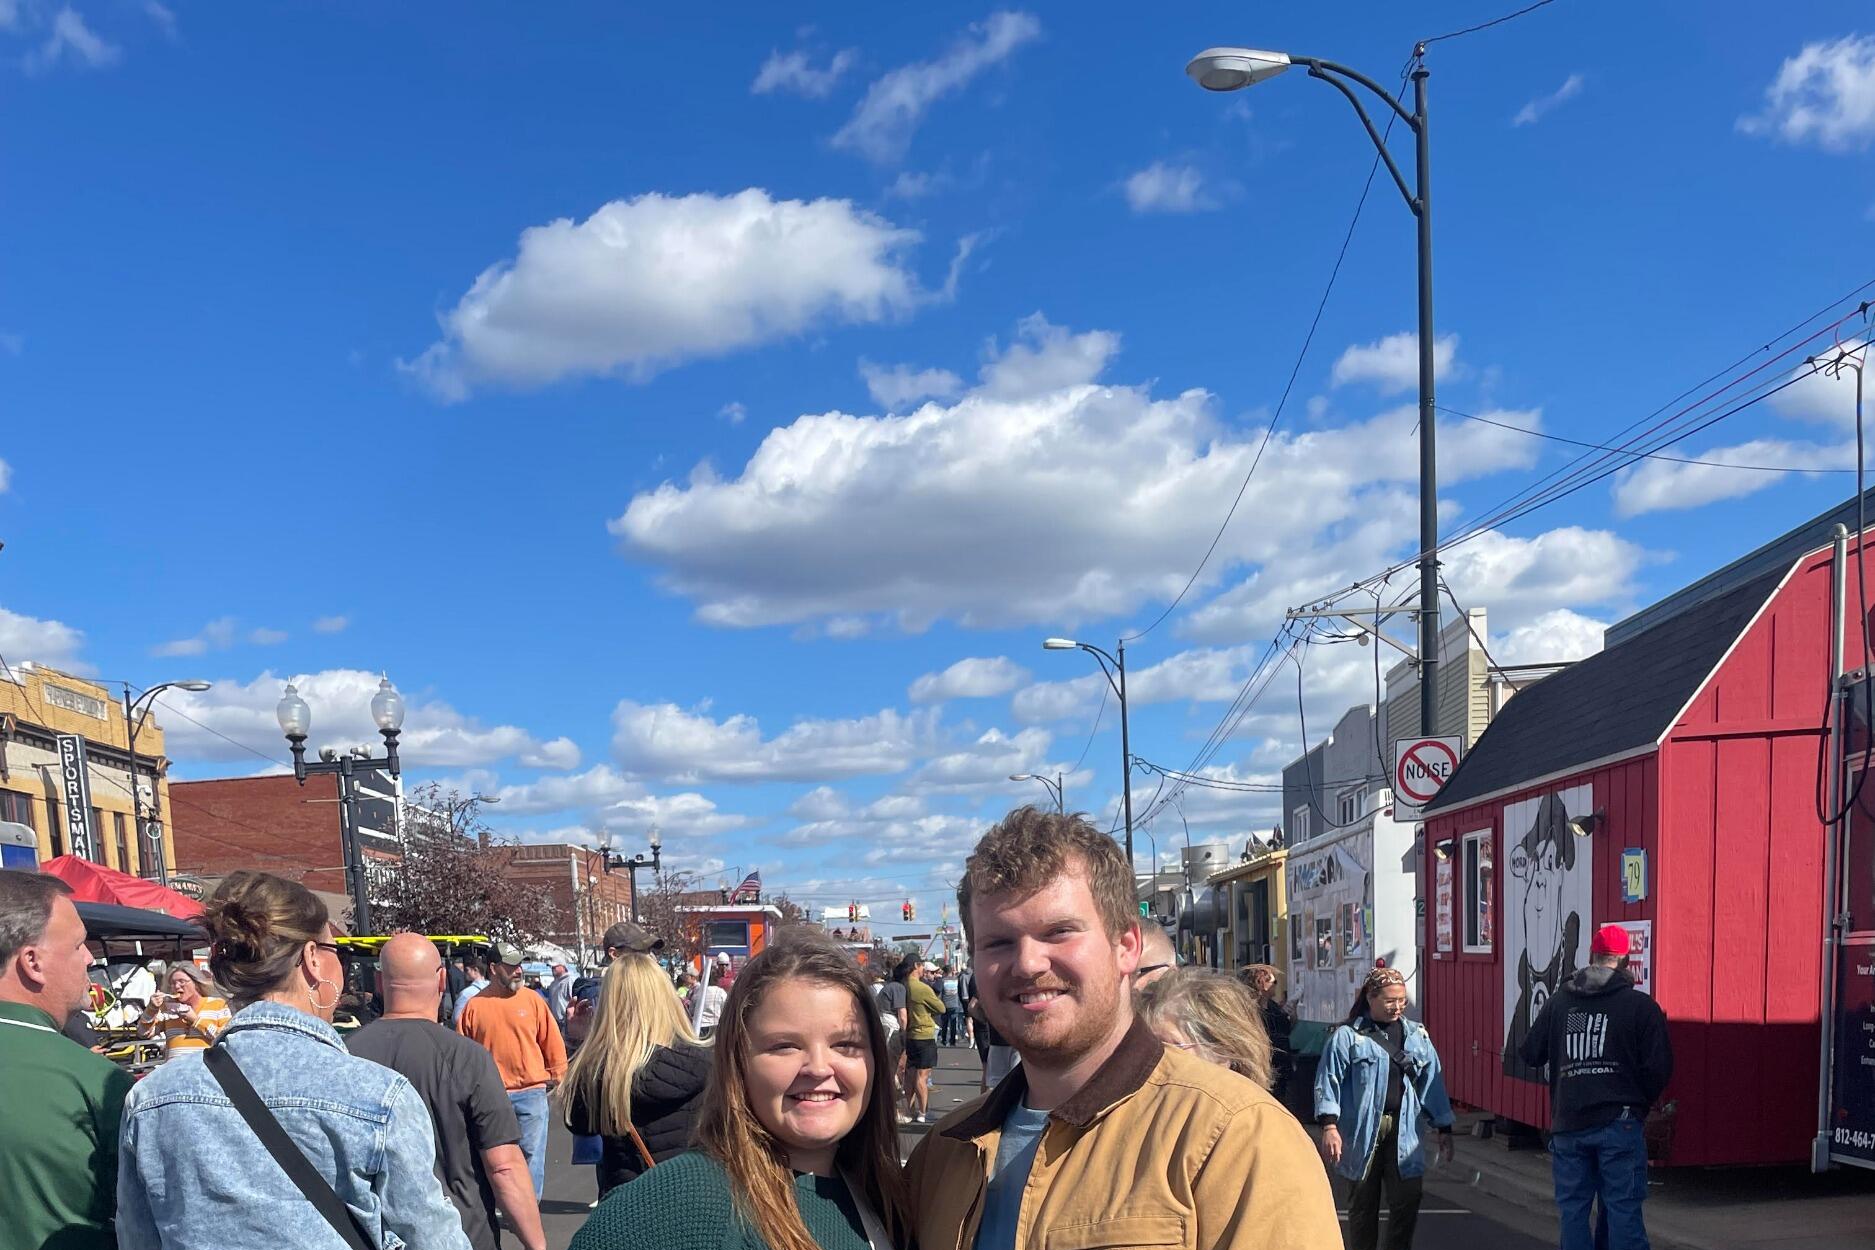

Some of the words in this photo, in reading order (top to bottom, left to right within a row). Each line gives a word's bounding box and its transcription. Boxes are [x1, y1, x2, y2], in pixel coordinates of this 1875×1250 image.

[1406, 761, 1450, 780] NOISE
[62, 739, 86, 860] SPORTSMAN
[1628, 860, 1641, 890] 79
